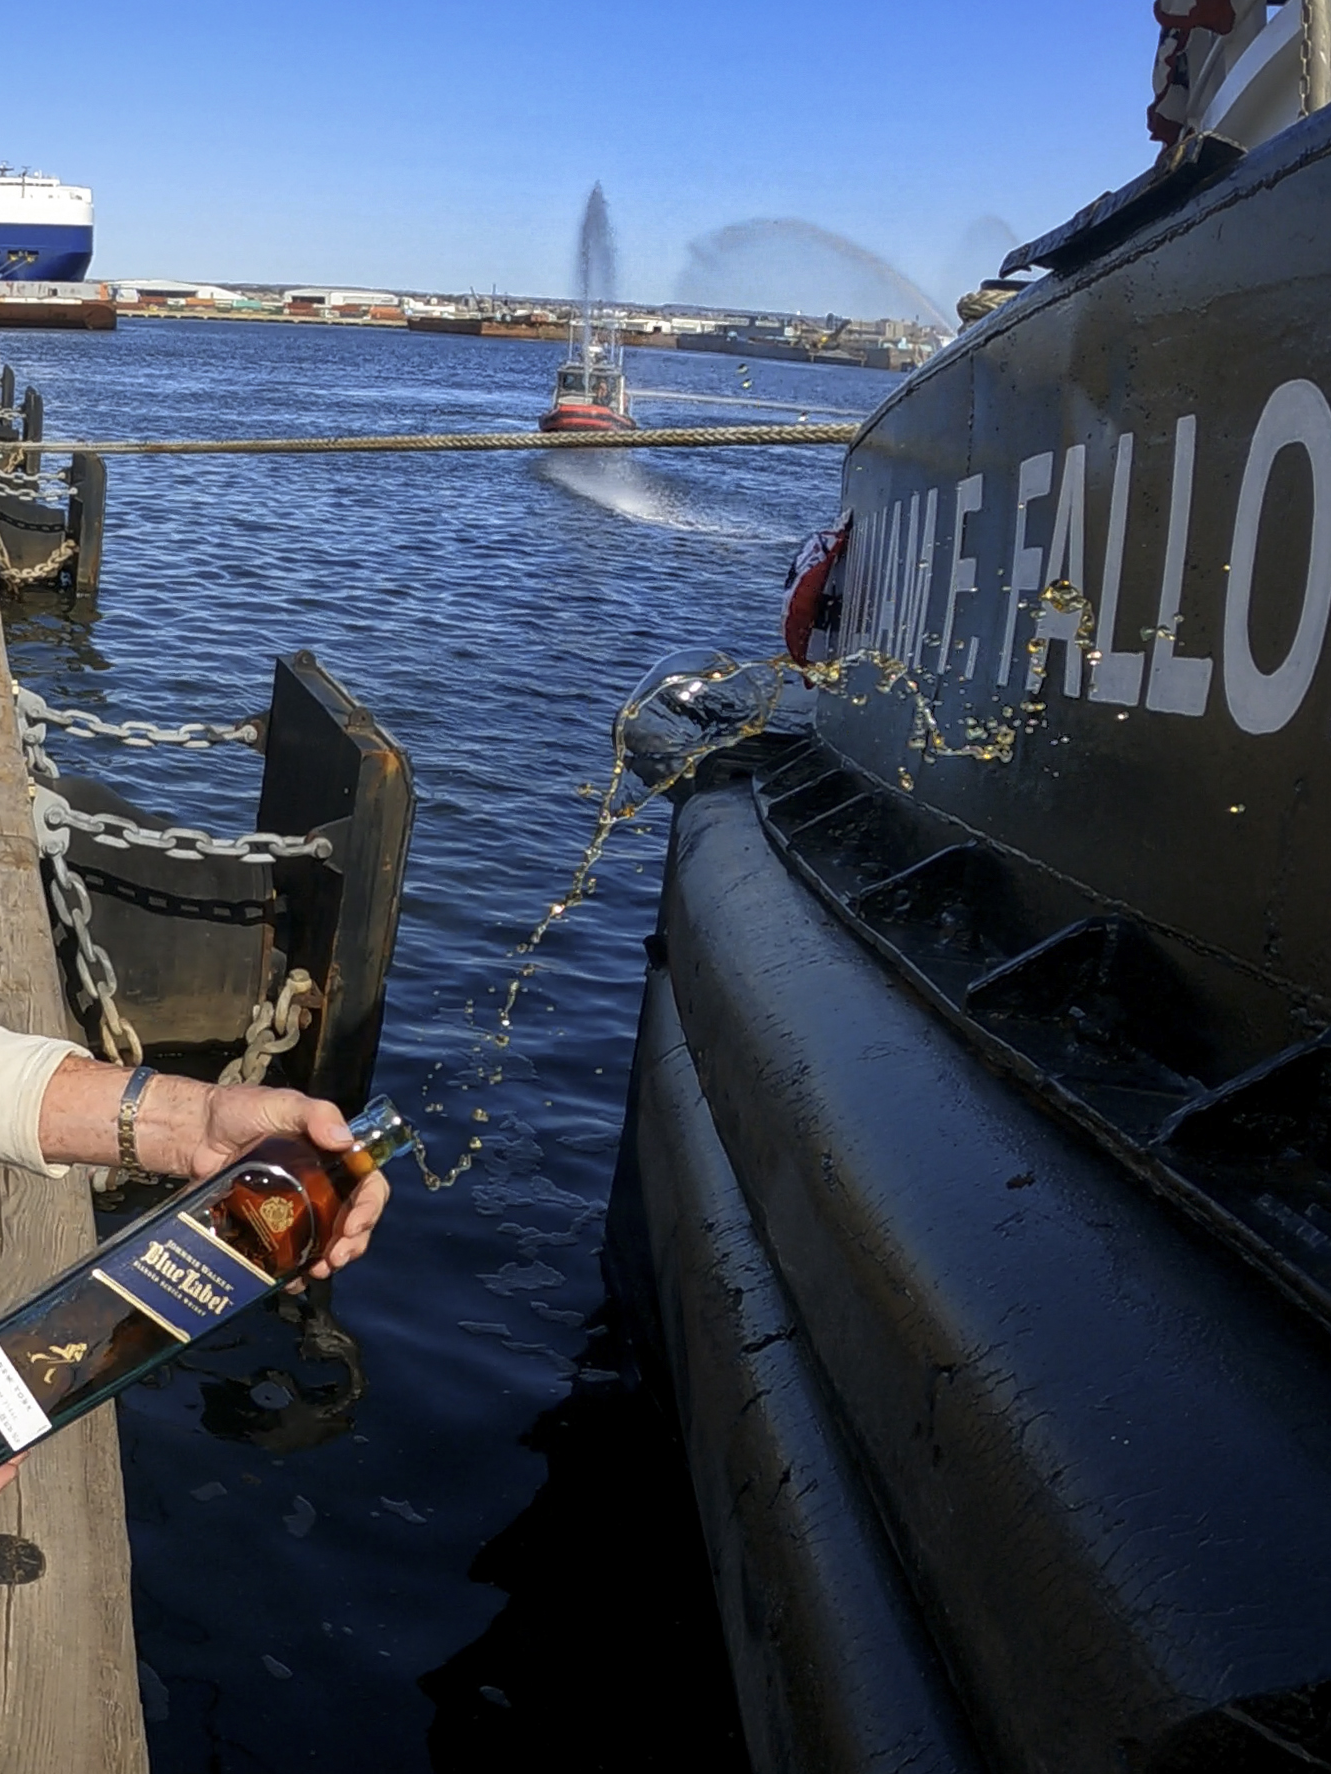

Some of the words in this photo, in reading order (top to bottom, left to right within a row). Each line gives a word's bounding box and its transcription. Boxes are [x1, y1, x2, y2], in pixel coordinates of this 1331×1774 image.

[997, 378, 1331, 736] FALLO
[140, 1241, 184, 1283] Blue
[178, 1270, 230, 1315] Label
